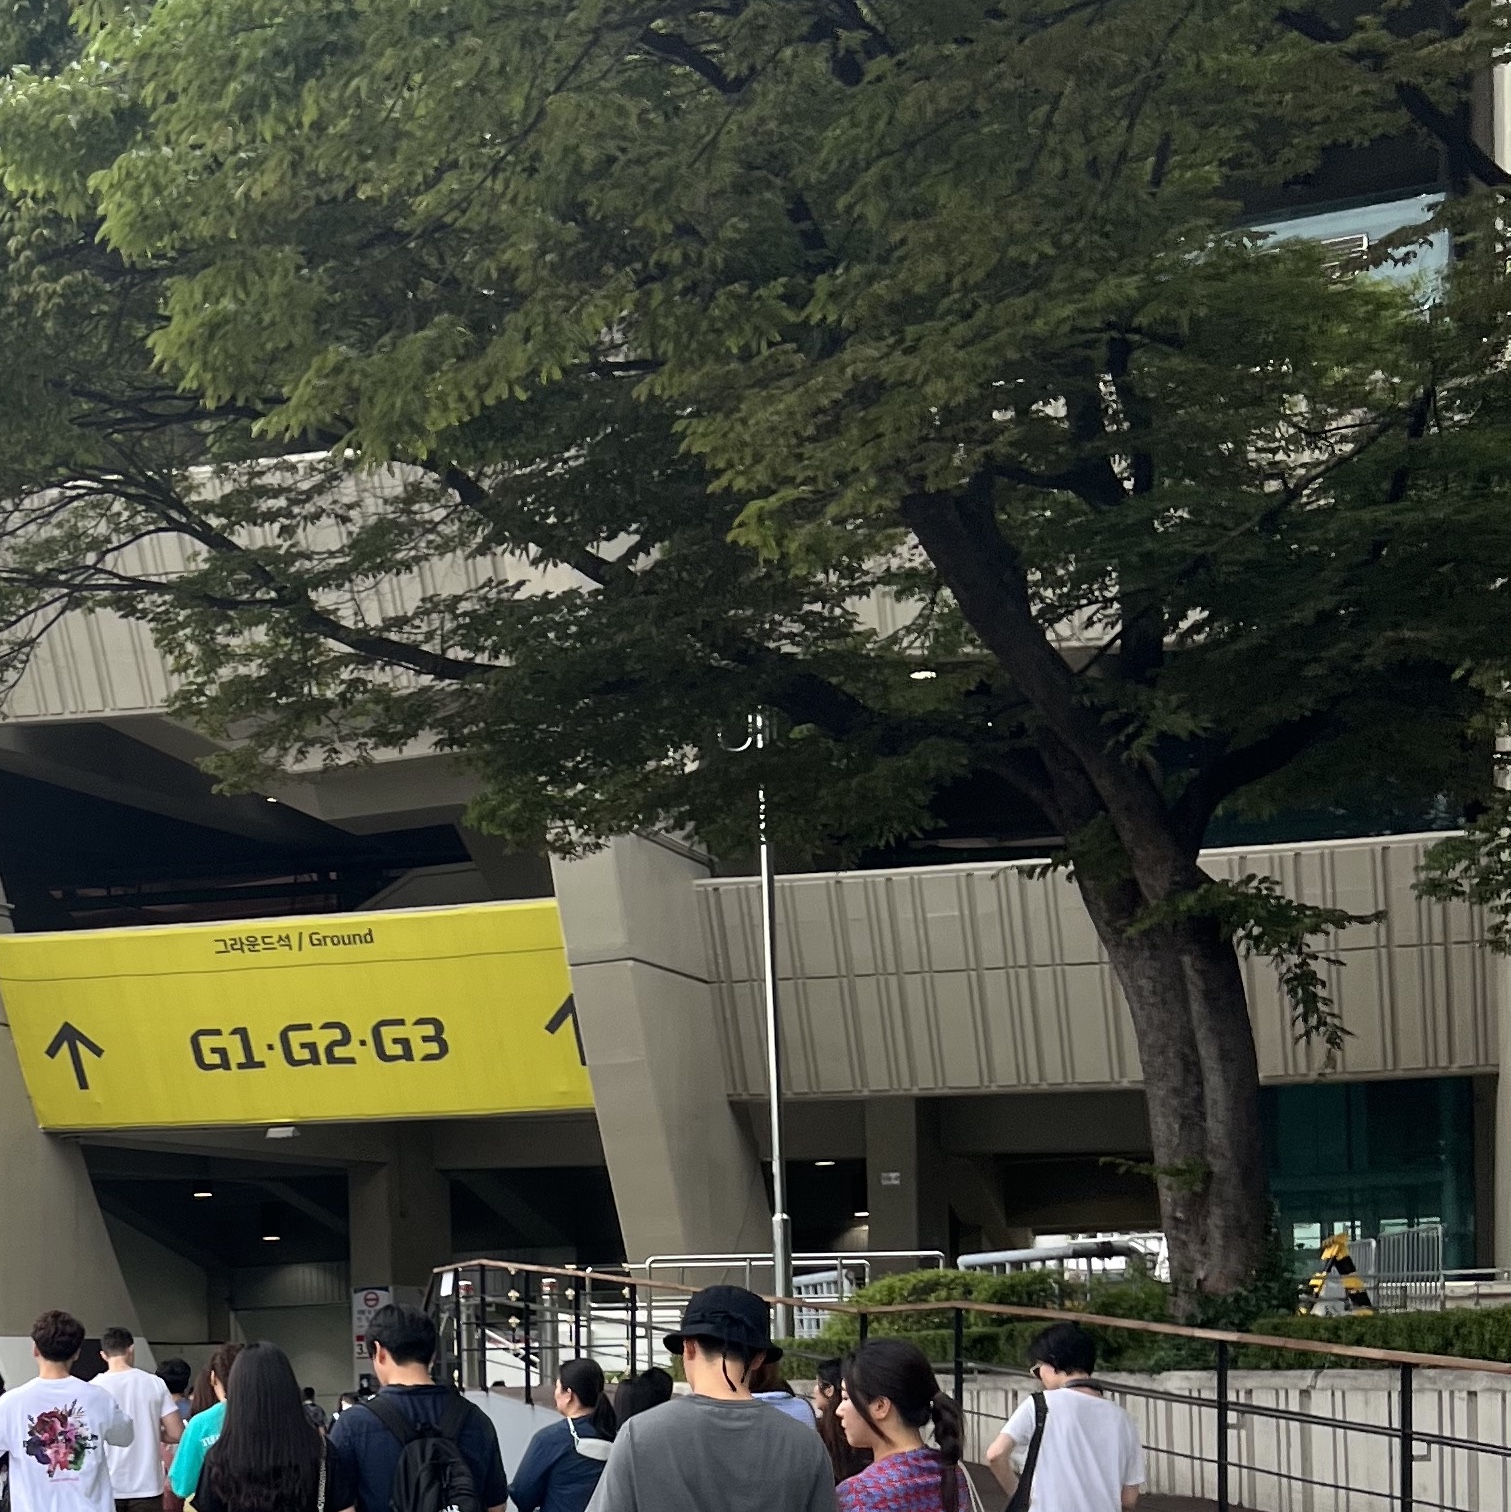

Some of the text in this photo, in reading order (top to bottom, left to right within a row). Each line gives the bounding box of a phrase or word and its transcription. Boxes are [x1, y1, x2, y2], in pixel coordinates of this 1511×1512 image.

[214, 934, 293, 955] 그라운드석
[308, 928, 374, 947] Ground
[190, 1017, 450, 1071] G1·G2·G3
